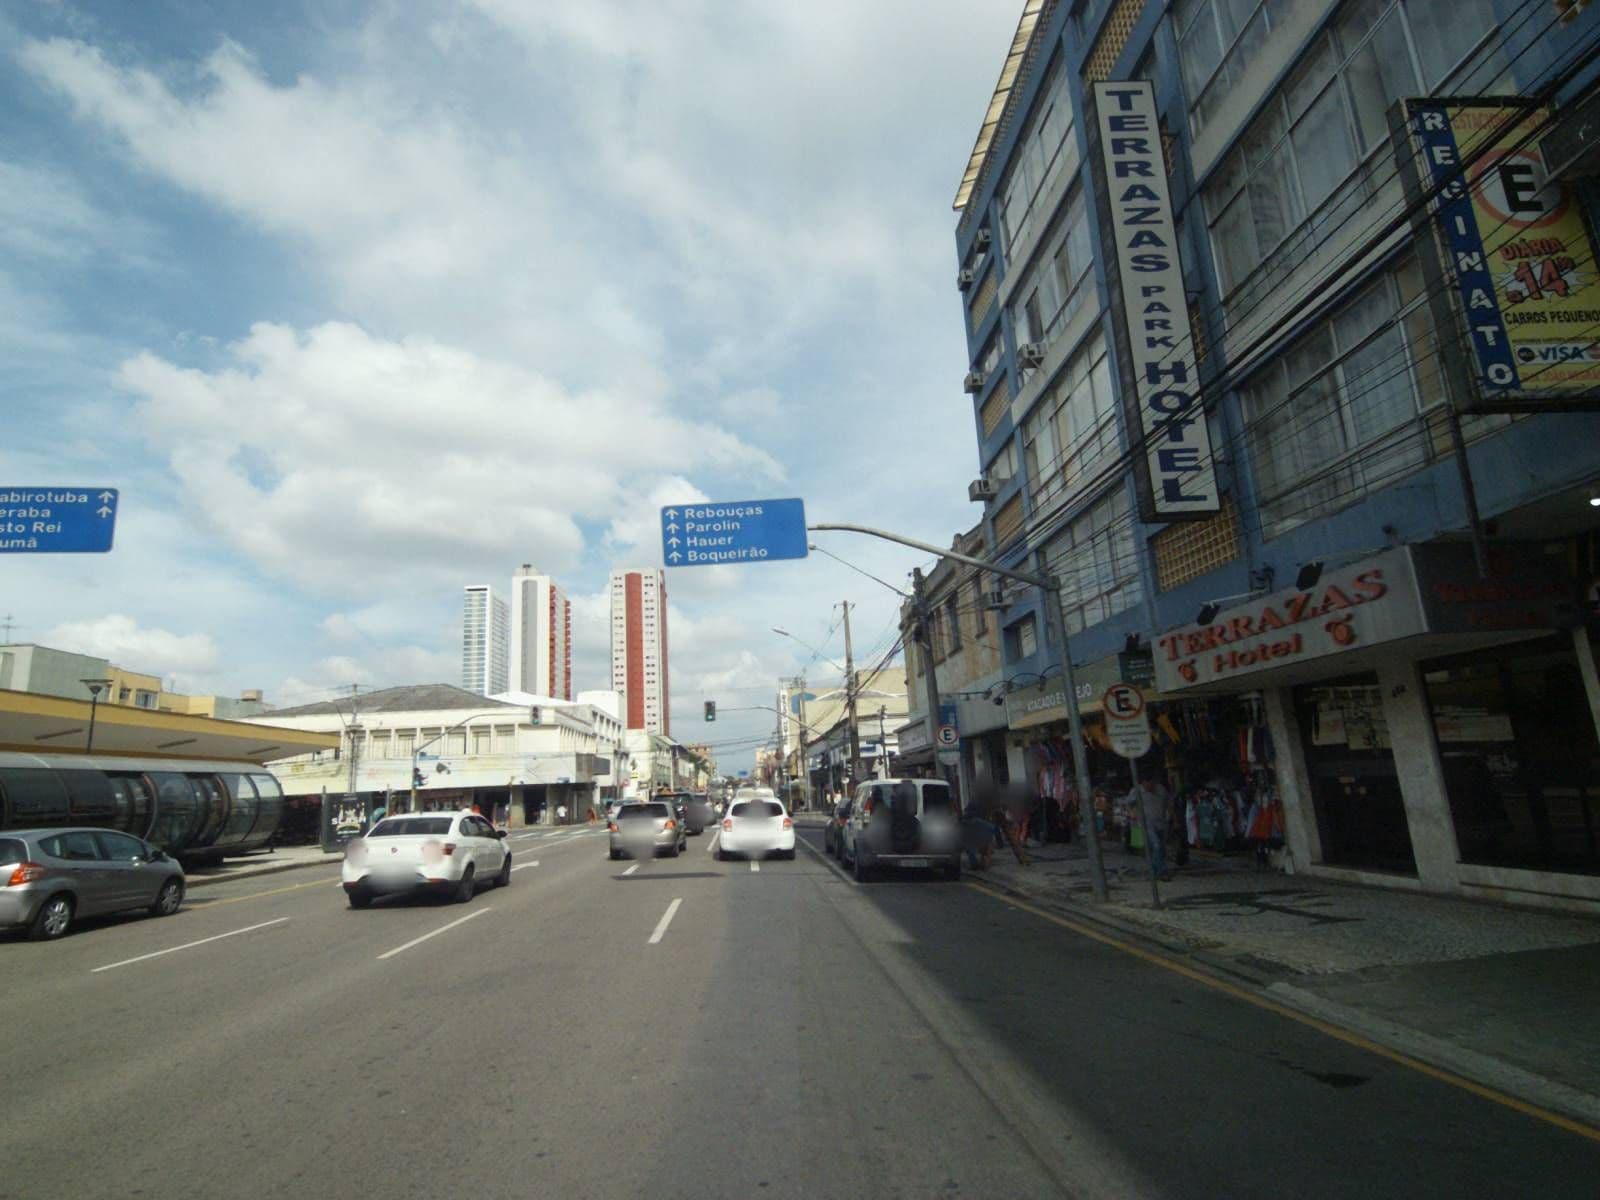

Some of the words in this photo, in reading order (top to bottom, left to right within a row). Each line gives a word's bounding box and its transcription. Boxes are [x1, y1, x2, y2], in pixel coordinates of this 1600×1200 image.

[1105, 89, 1171, 273] TERRAZAS
[1497, 163, 1545, 213] E
[1141, 285, 1178, 349] PARK
[1504, 311, 1547, 325] CARROS
[1550, 310, 1600, 323] PEQUENO
[1537, 346, 1584, 361] VISA
[1144, 359, 1208, 503] HOTEL
[684, 505, 764, 519] Rebouças
[32, 521, 62, 533] Rei
[685, 520, 741, 533] Parolin
[686, 536, 734, 547] Hauer
[687, 548, 768, 562] Boqueirão
[1159, 569, 1388, 662] TERRAZAS
[1214, 633, 1303, 673] Hotel
[943, 729, 952, 741] E
